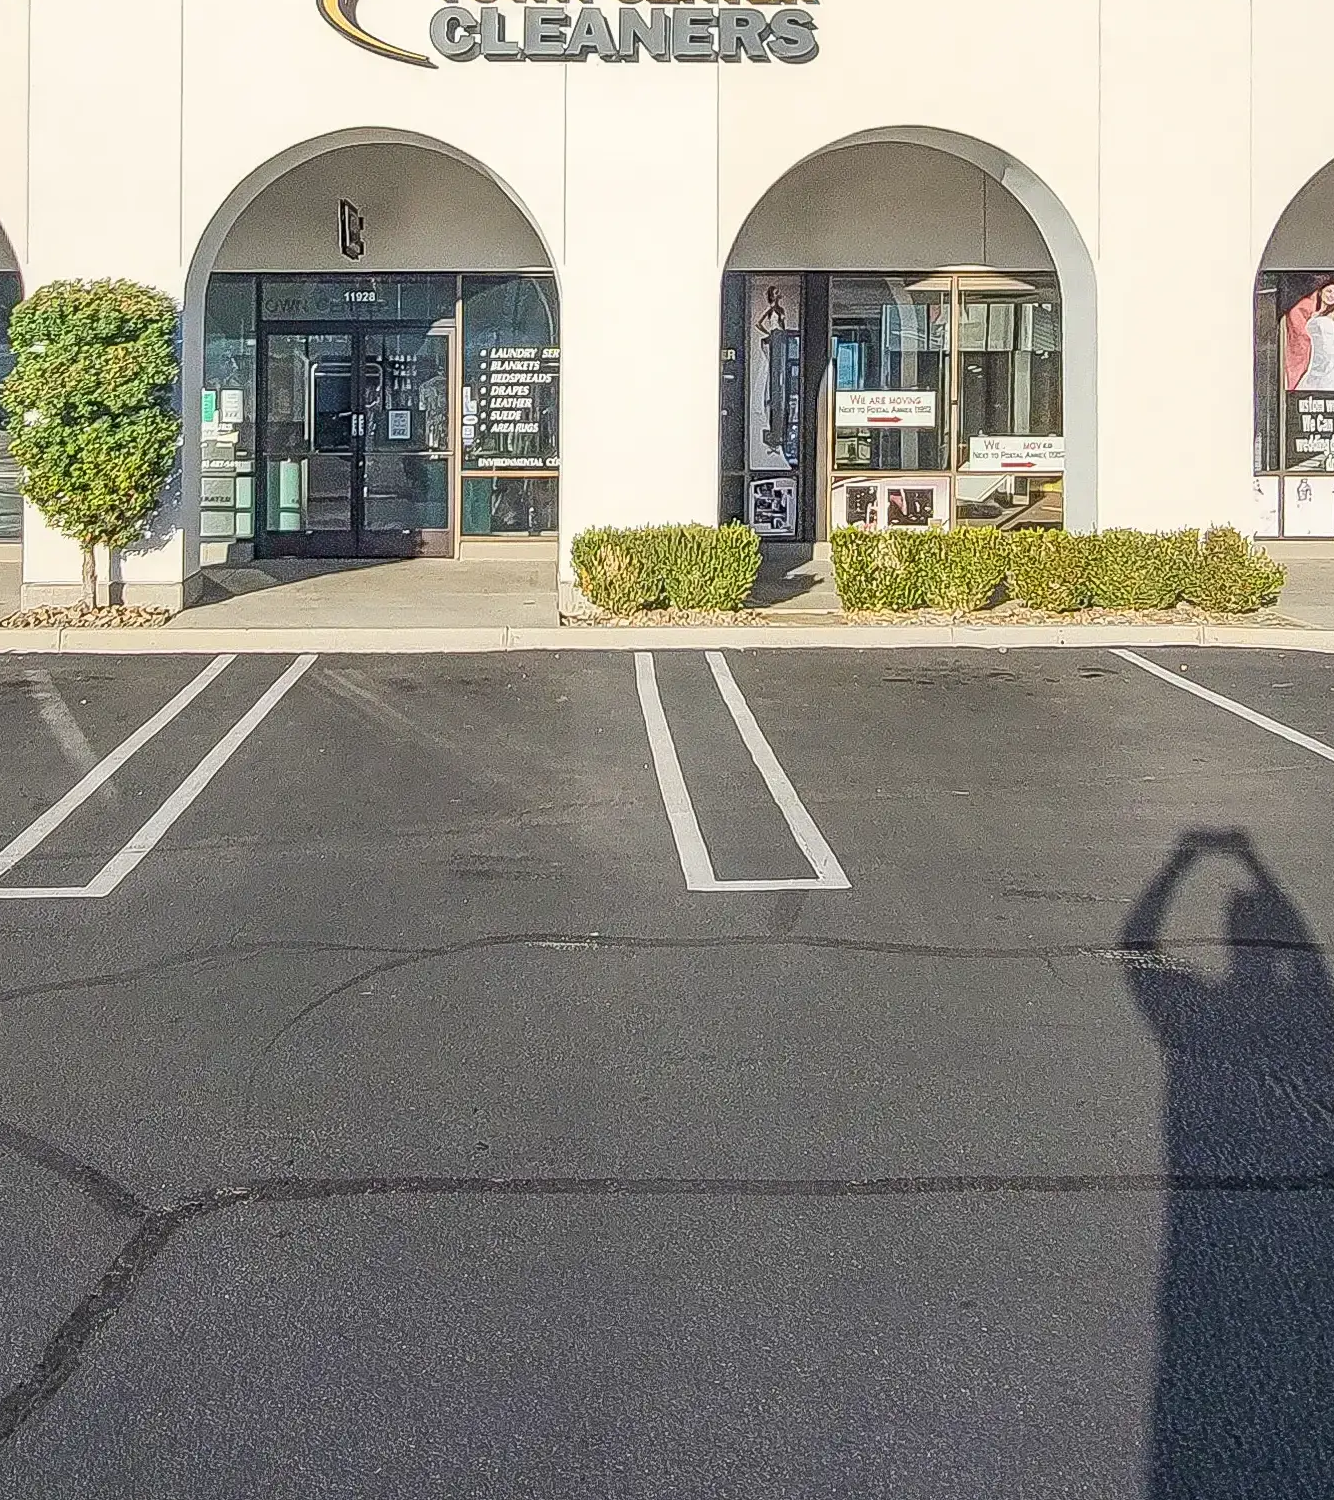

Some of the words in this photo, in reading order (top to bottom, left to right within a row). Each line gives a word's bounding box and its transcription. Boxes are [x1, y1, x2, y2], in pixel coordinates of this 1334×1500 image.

[430, 6, 820, 63] CLEANERS
[344, 291, 376, 302] 11928
[490, 348, 538, 358] LAUNDRY
[490, 361, 540, 371] BLANKETS
[490, 373, 552, 383] BEDSPREADS
[490, 386, 530, 396] DRAPES
[490, 398, 533, 408] LEATHER
[490, 411, 522, 420] SUEDE
[490, 423, 514, 433] AREA
[515, 423, 539, 433] RUGS
[1302, 414, 1316, 432] We
[1317, 414, 1334, 432] Can
[1295, 434, 1330, 456] wedding
